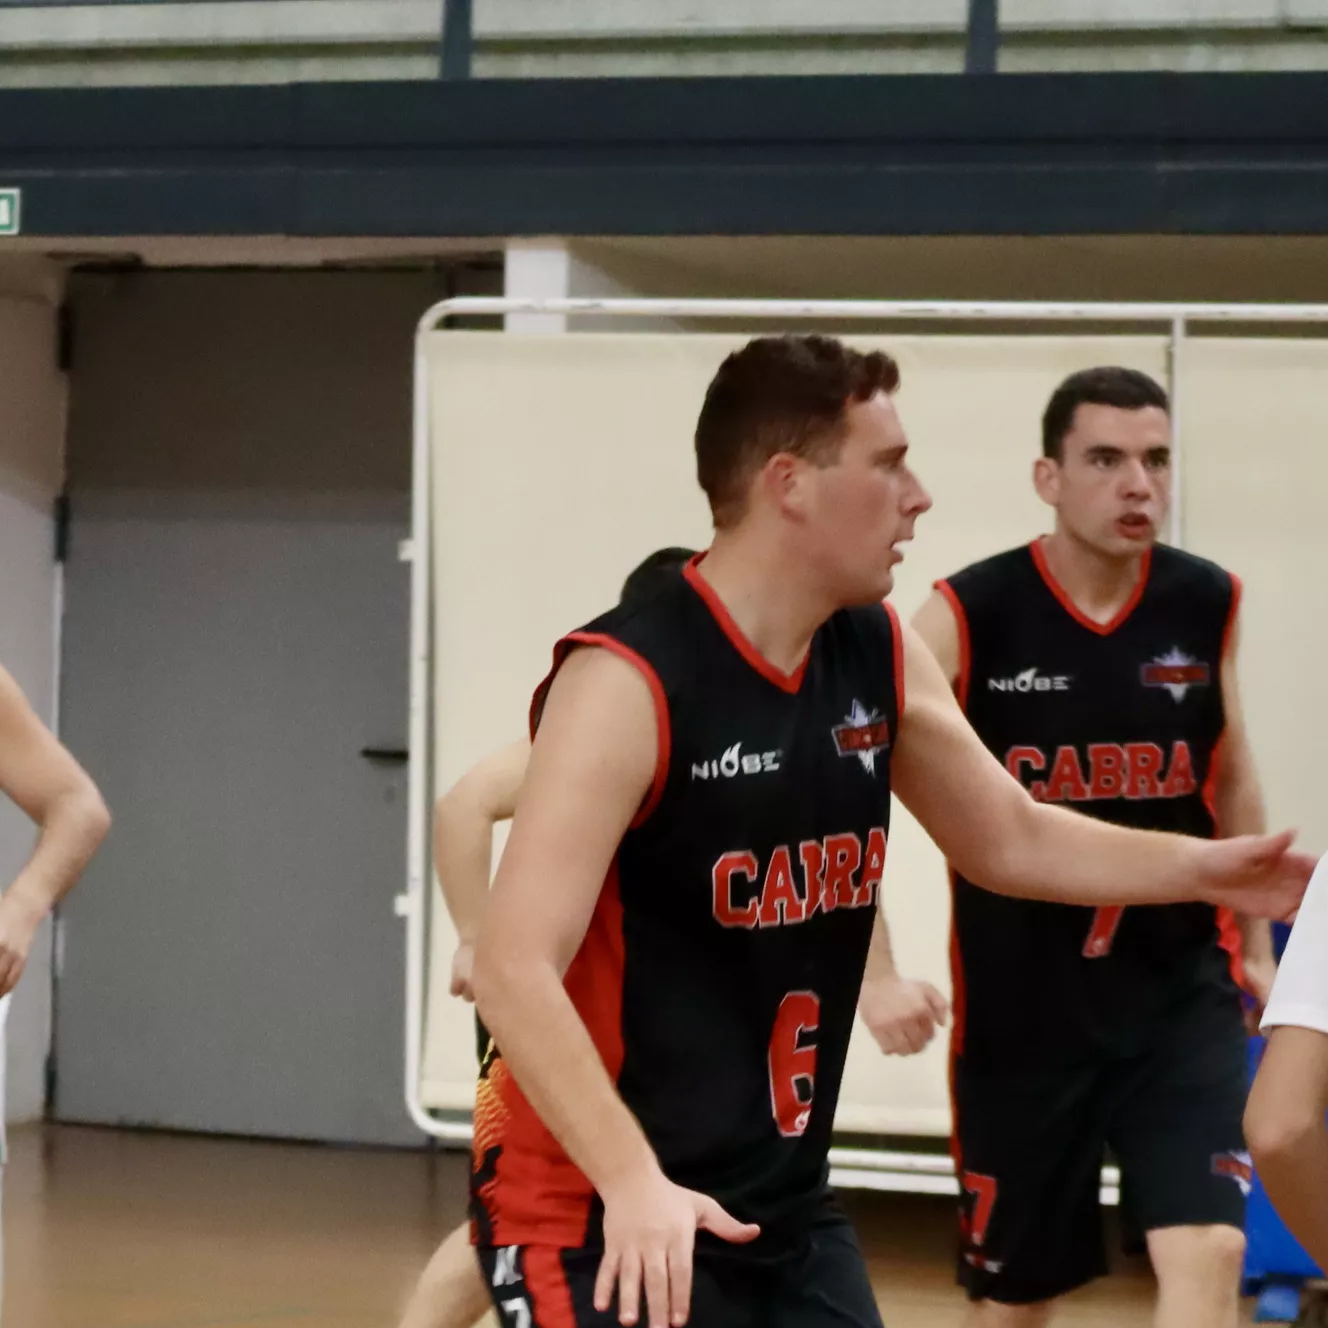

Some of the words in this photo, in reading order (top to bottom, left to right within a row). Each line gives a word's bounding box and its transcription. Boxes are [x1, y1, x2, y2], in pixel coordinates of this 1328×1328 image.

[988, 668, 1071, 692] NIOBE
[691, 741, 782, 780] NIOBE
[1005, 741, 1197, 800] CABRA
[768, 989, 820, 1138] 6
[962, 1170, 997, 1246] 7
